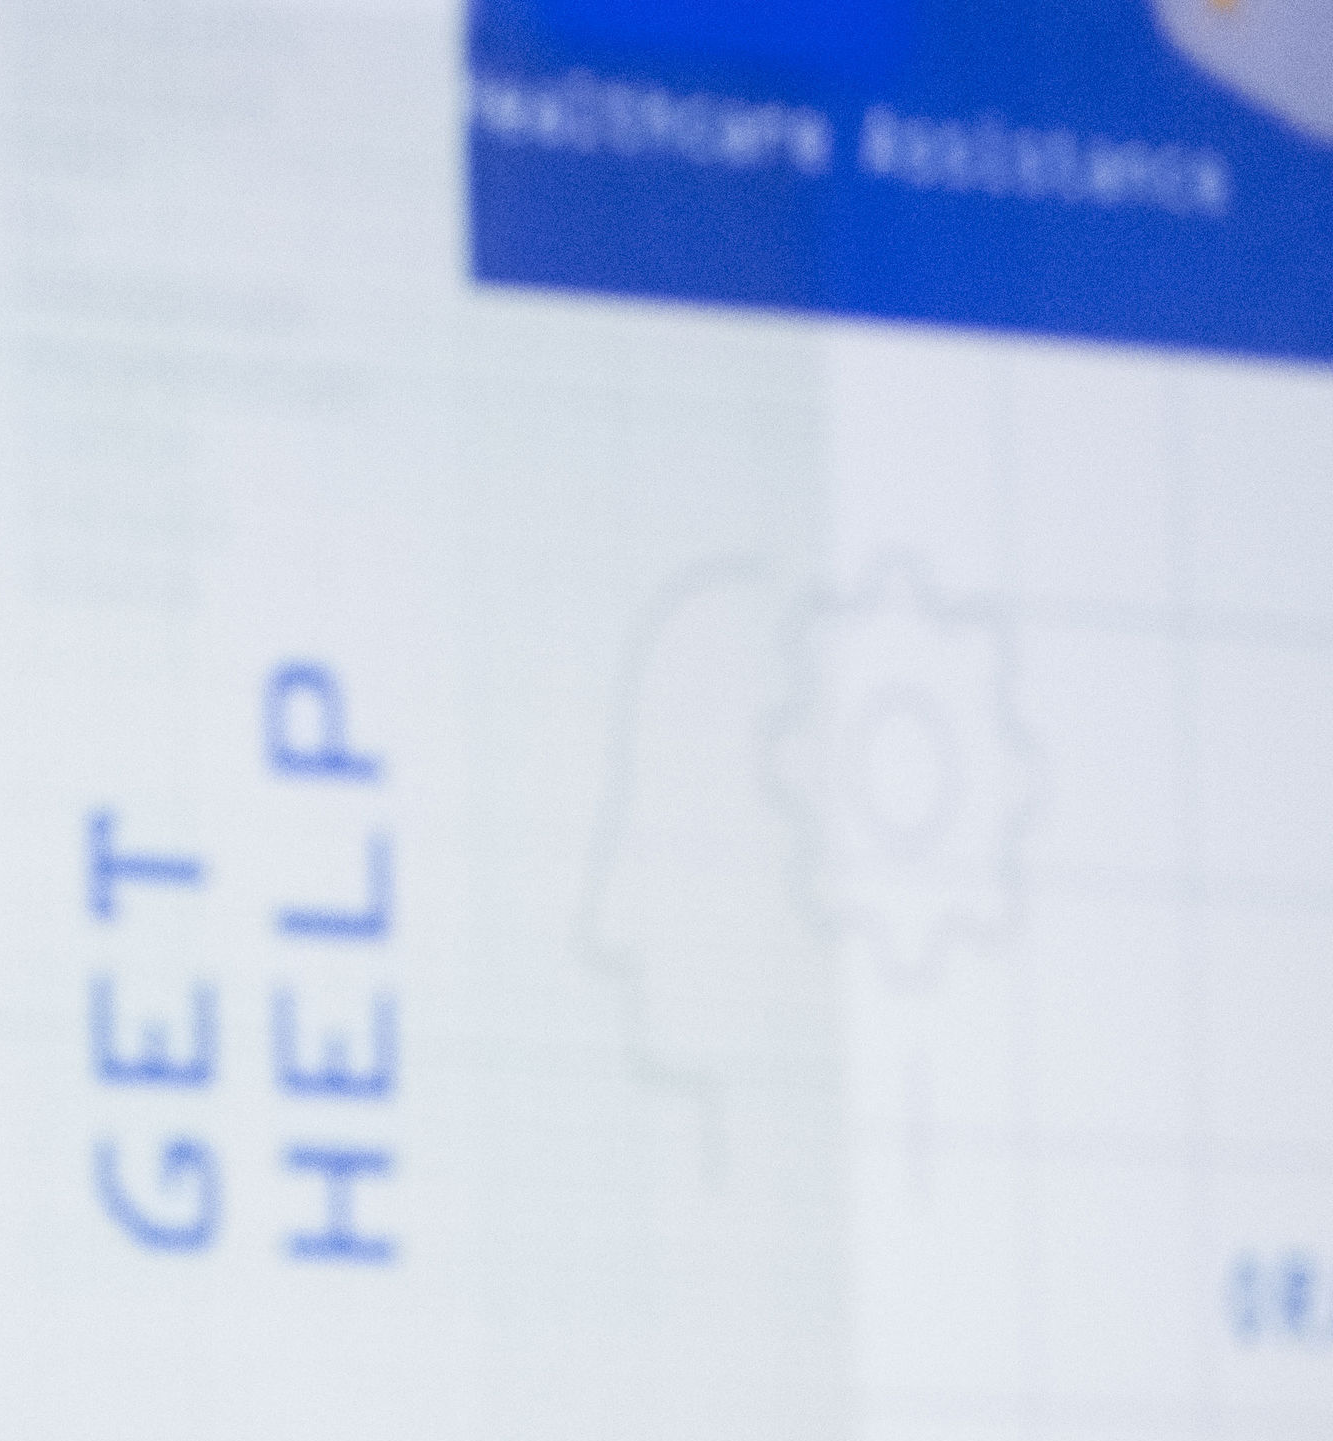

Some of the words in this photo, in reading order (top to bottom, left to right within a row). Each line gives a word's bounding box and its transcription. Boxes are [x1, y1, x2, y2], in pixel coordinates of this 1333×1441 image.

[859, 102, 1231, 218] Assistance
[83, 804, 224, 1258] GET
[262, 656, 402, 1269] HELP
